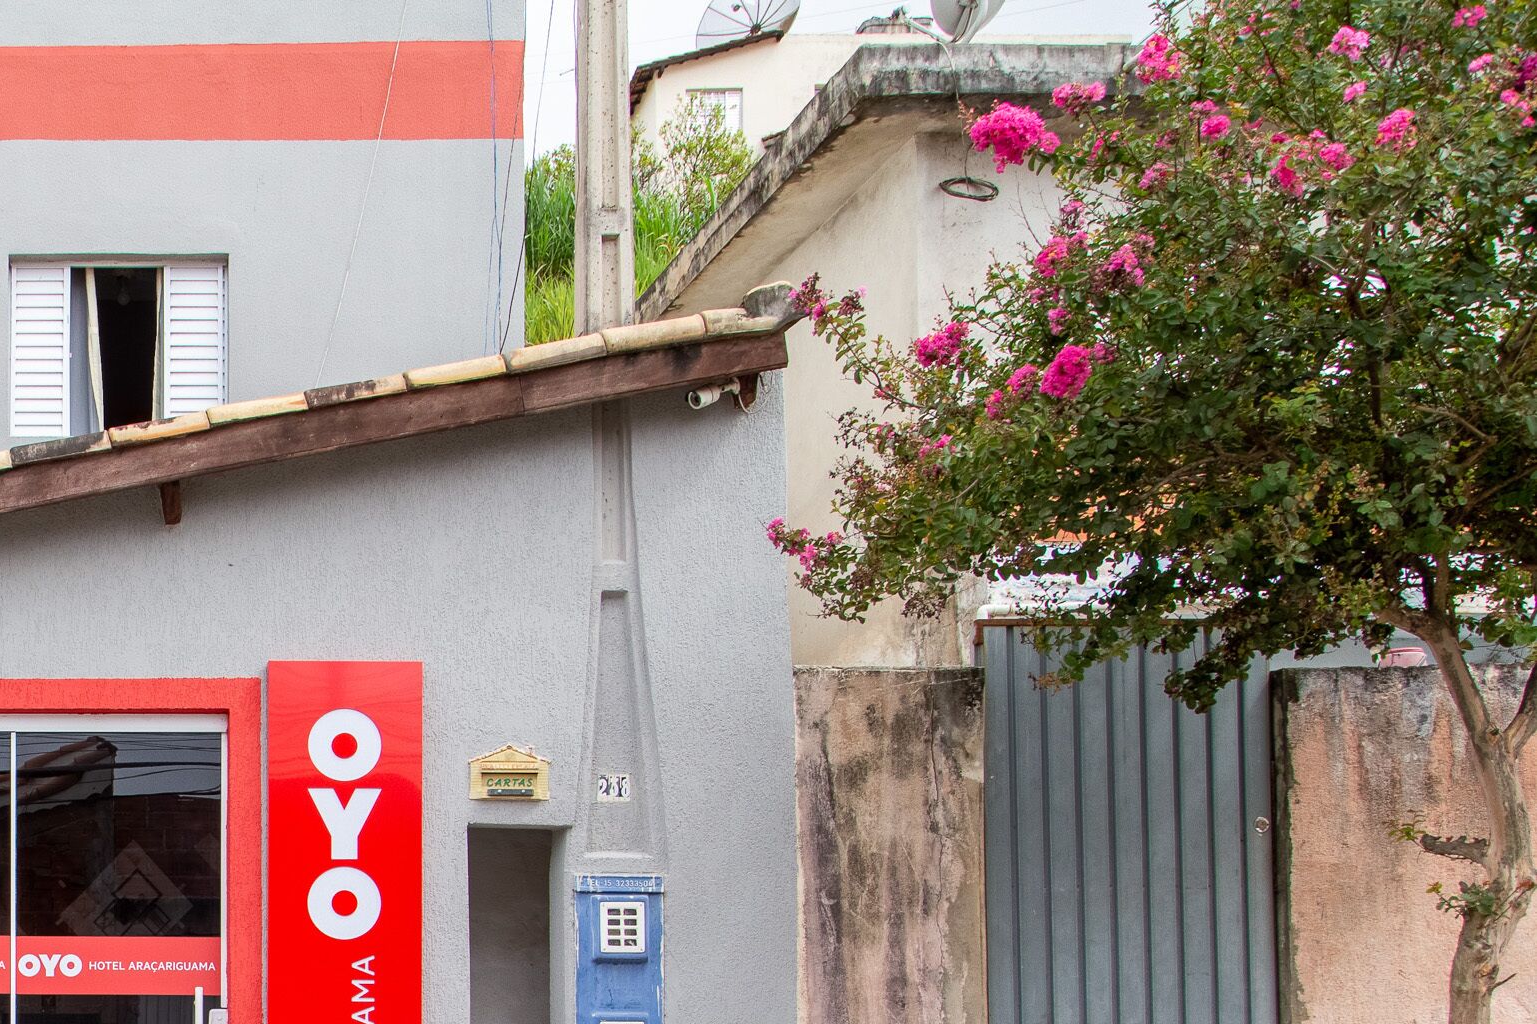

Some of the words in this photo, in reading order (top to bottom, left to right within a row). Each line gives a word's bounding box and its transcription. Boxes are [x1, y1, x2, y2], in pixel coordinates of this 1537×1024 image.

[486, 777, 534, 788] CARTAS
[307, 708, 382, 940] OYO
[18, 953, 82, 977] OYO
[88, 961, 125, 971] HOTEL
[128, 960, 216, 973] ARAÇARIGUAMA
